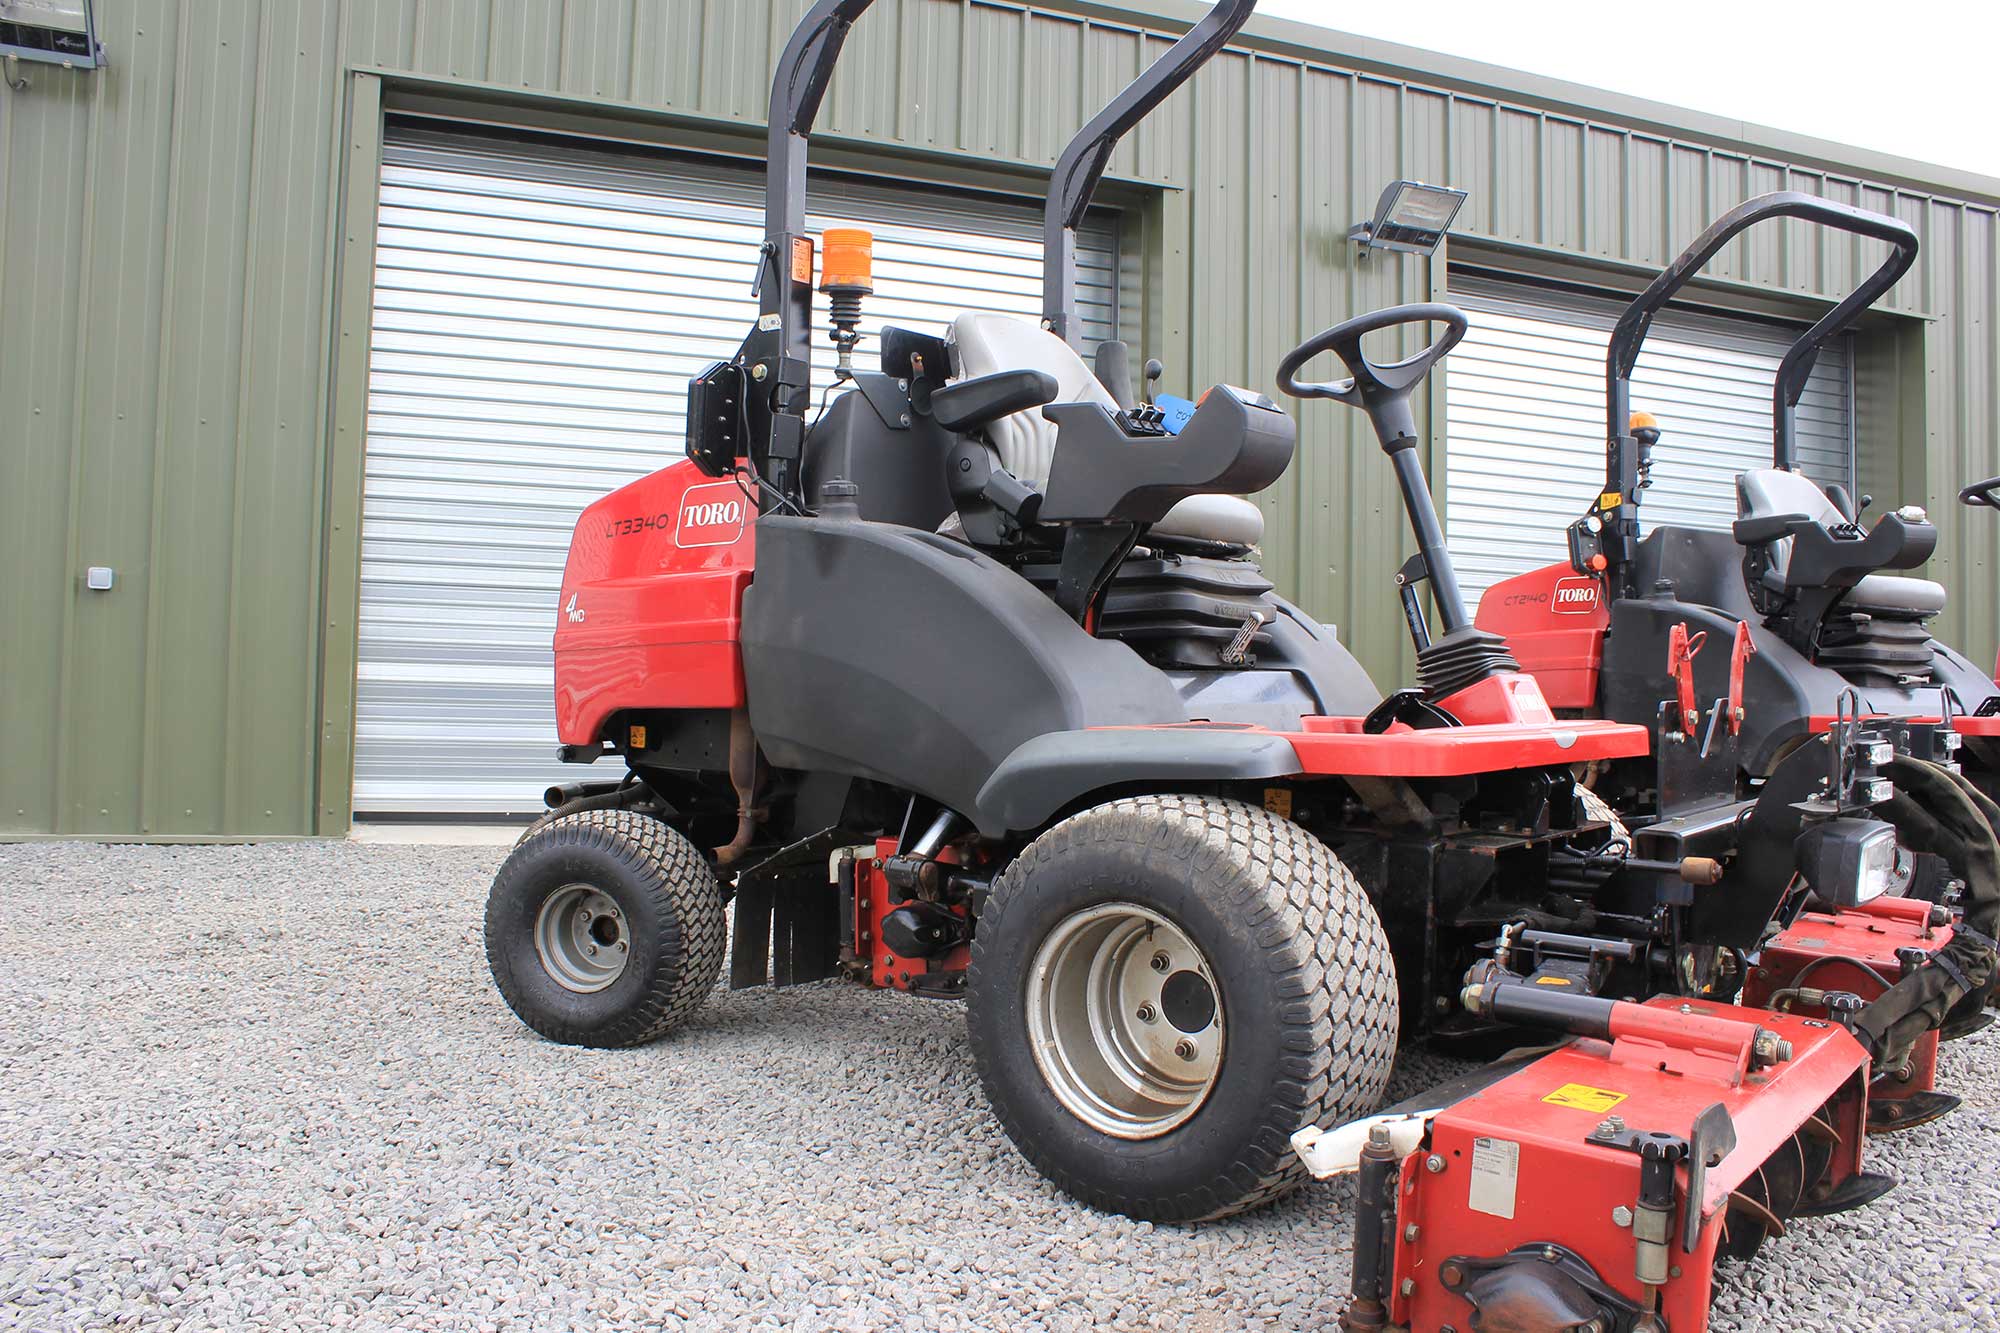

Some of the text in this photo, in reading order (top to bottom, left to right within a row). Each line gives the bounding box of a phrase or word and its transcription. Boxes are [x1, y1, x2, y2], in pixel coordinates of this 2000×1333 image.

[606, 513, 669, 538] LT3340
[684, 500, 738, 528] TORO
[1557, 588, 1593, 603] TORO
